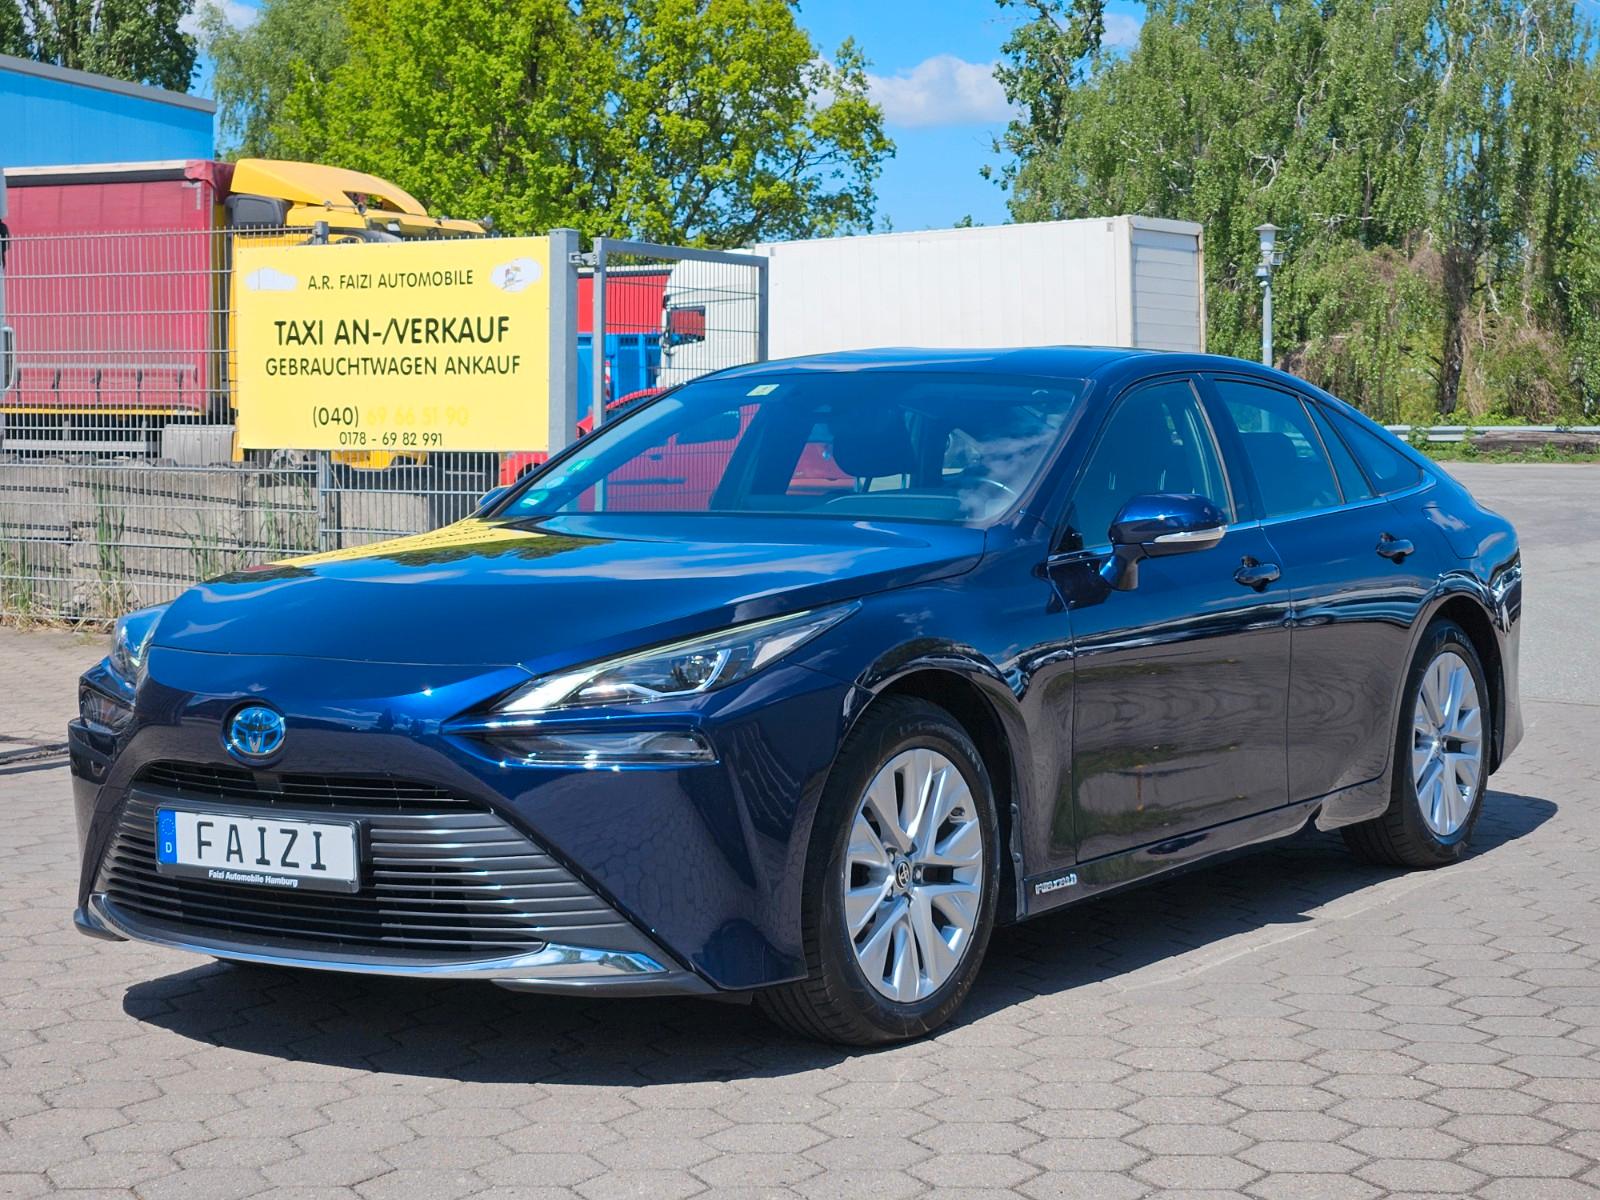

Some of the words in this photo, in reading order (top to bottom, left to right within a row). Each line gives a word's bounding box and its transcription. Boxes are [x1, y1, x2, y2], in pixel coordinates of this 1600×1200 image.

[307, 275, 334, 290] A.R.
[339, 274, 372, 289] FAIZI
[377, 269, 473, 289] AUTOMOBILE
[273, 319, 324, 346] TAXI
[333, 315, 510, 346] AN-/VERKAUF
[265, 356, 437, 377] GEBRAUCHTWAGEN
[444, 355, 521, 375] ANKAUF
[312, 406, 359, 428] (040)
[339, 431, 367, 446] 0178
[382, 431, 398, 446] 69
[402, 432, 417, 446] 82
[422, 432, 443, 447] 991
[165, 841, 173, 854] D
[196, 821, 327, 871] FAIZI
[208, 869, 225, 880] Faizi
[225, 871, 265, 884] Automobile
[265, 875, 299, 888] Hamburg
